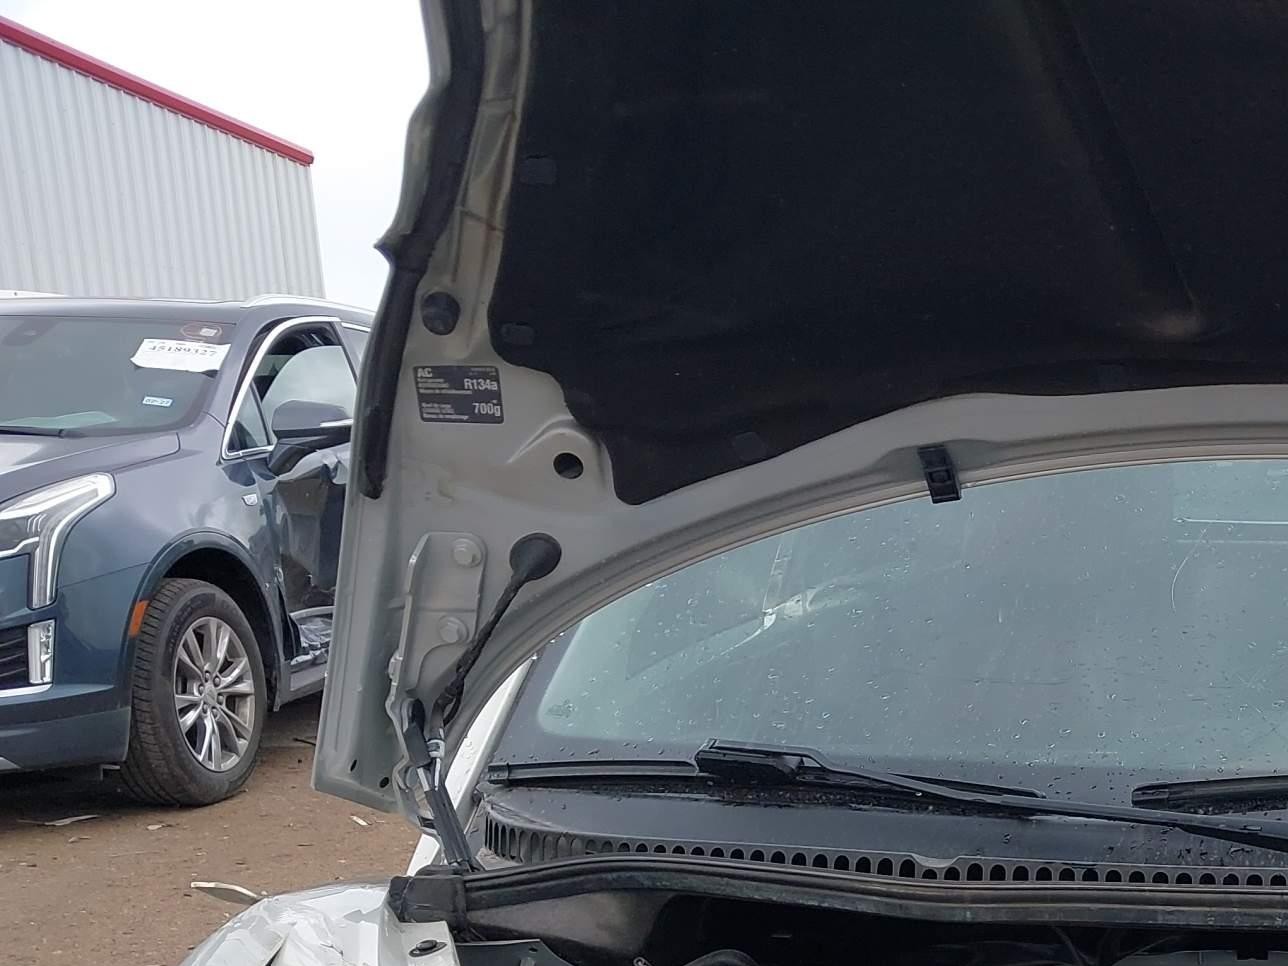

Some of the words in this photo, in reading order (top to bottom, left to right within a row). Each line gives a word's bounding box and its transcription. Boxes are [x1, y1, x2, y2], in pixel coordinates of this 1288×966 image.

[417, 368, 432, 377] AC
[464, 379, 497, 390] R134a
[472, 403, 501, 416] 700g
